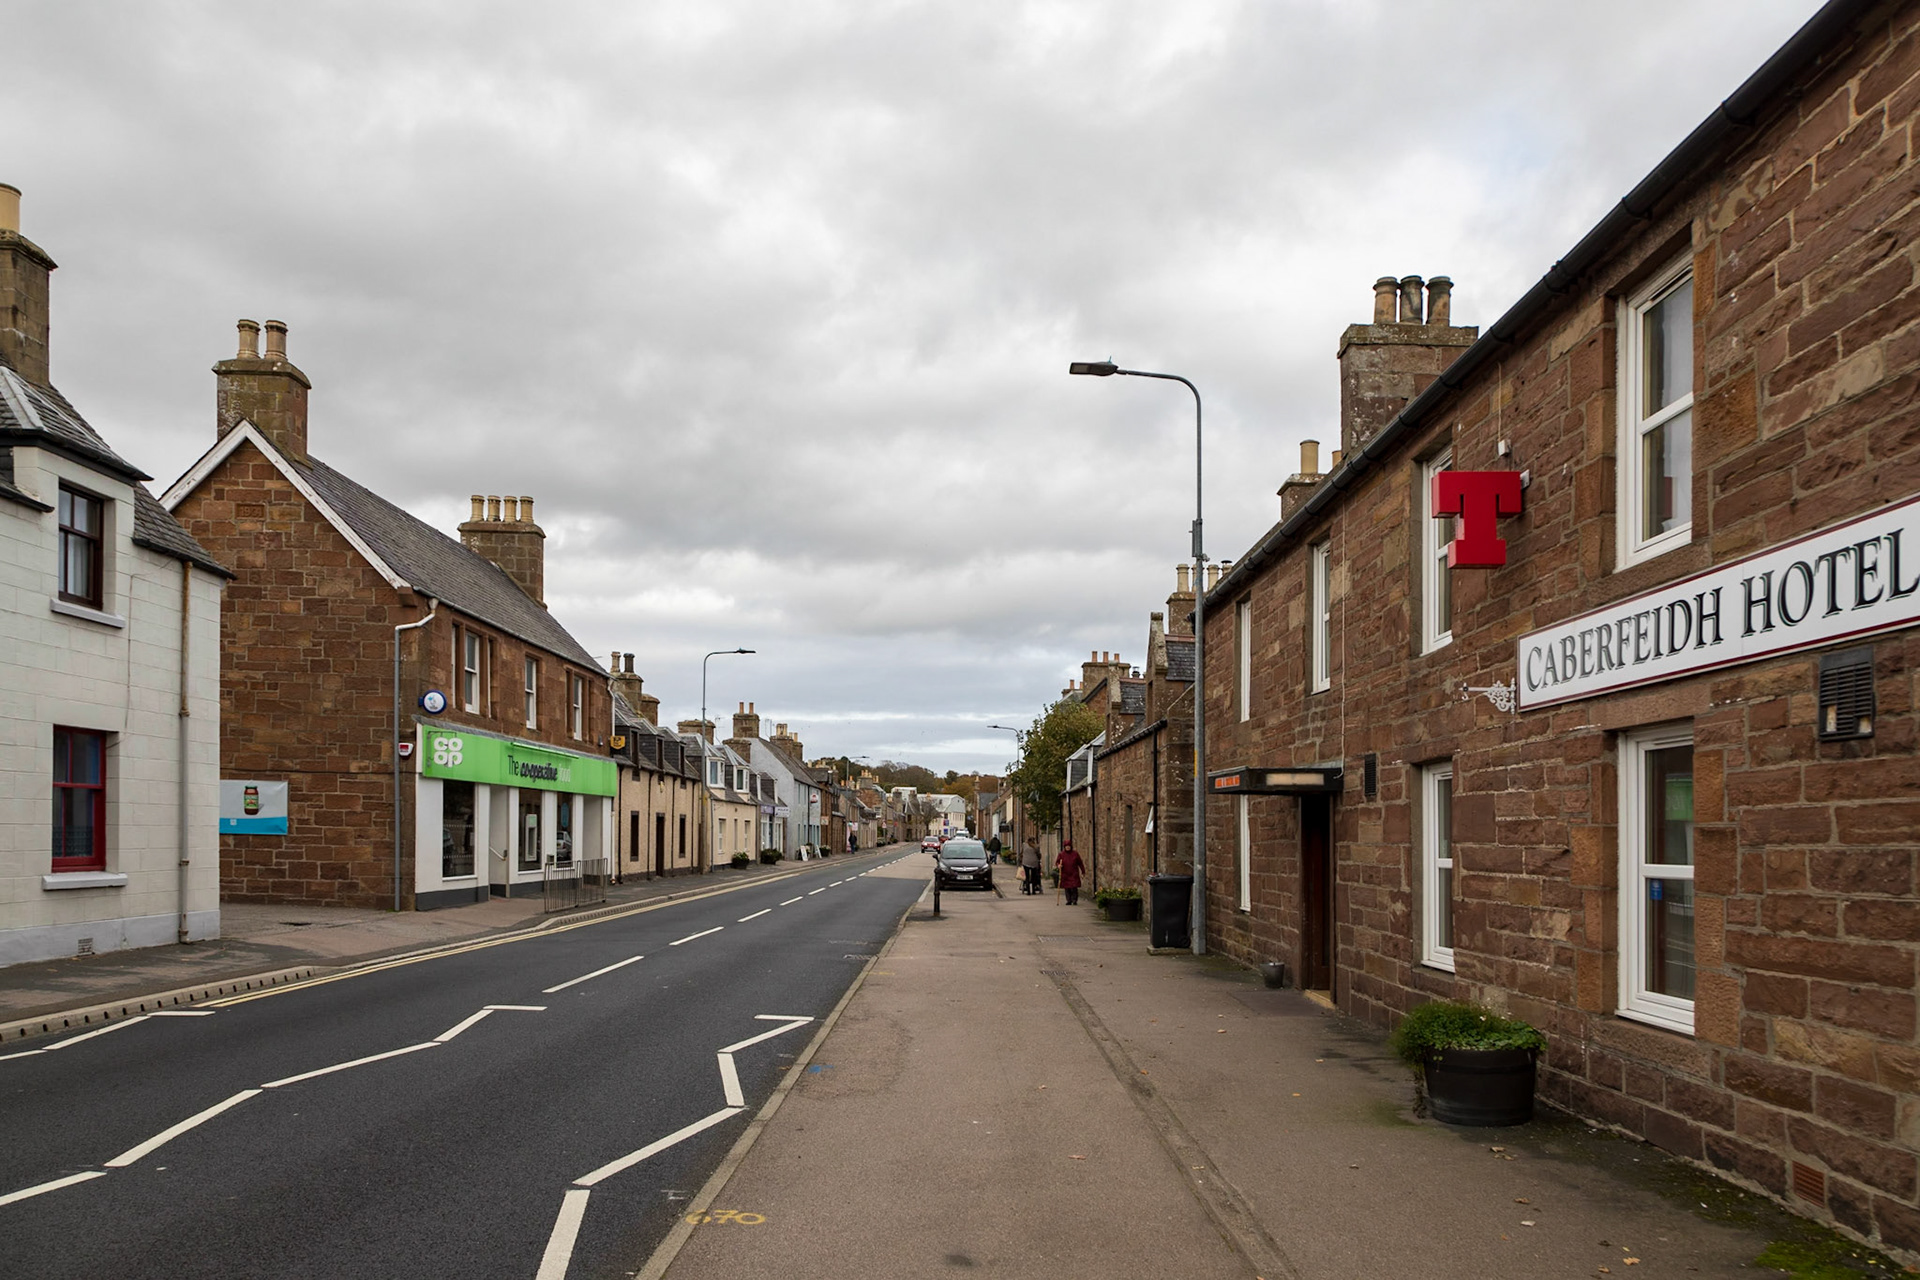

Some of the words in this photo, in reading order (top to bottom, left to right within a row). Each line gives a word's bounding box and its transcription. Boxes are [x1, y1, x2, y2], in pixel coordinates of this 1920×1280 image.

[1432, 471, 1522, 569] T
[1526, 586, 1724, 692] CABERFEIDH
[1740, 528, 1920, 638] HOTEL
[507, 755, 519, 777] The
